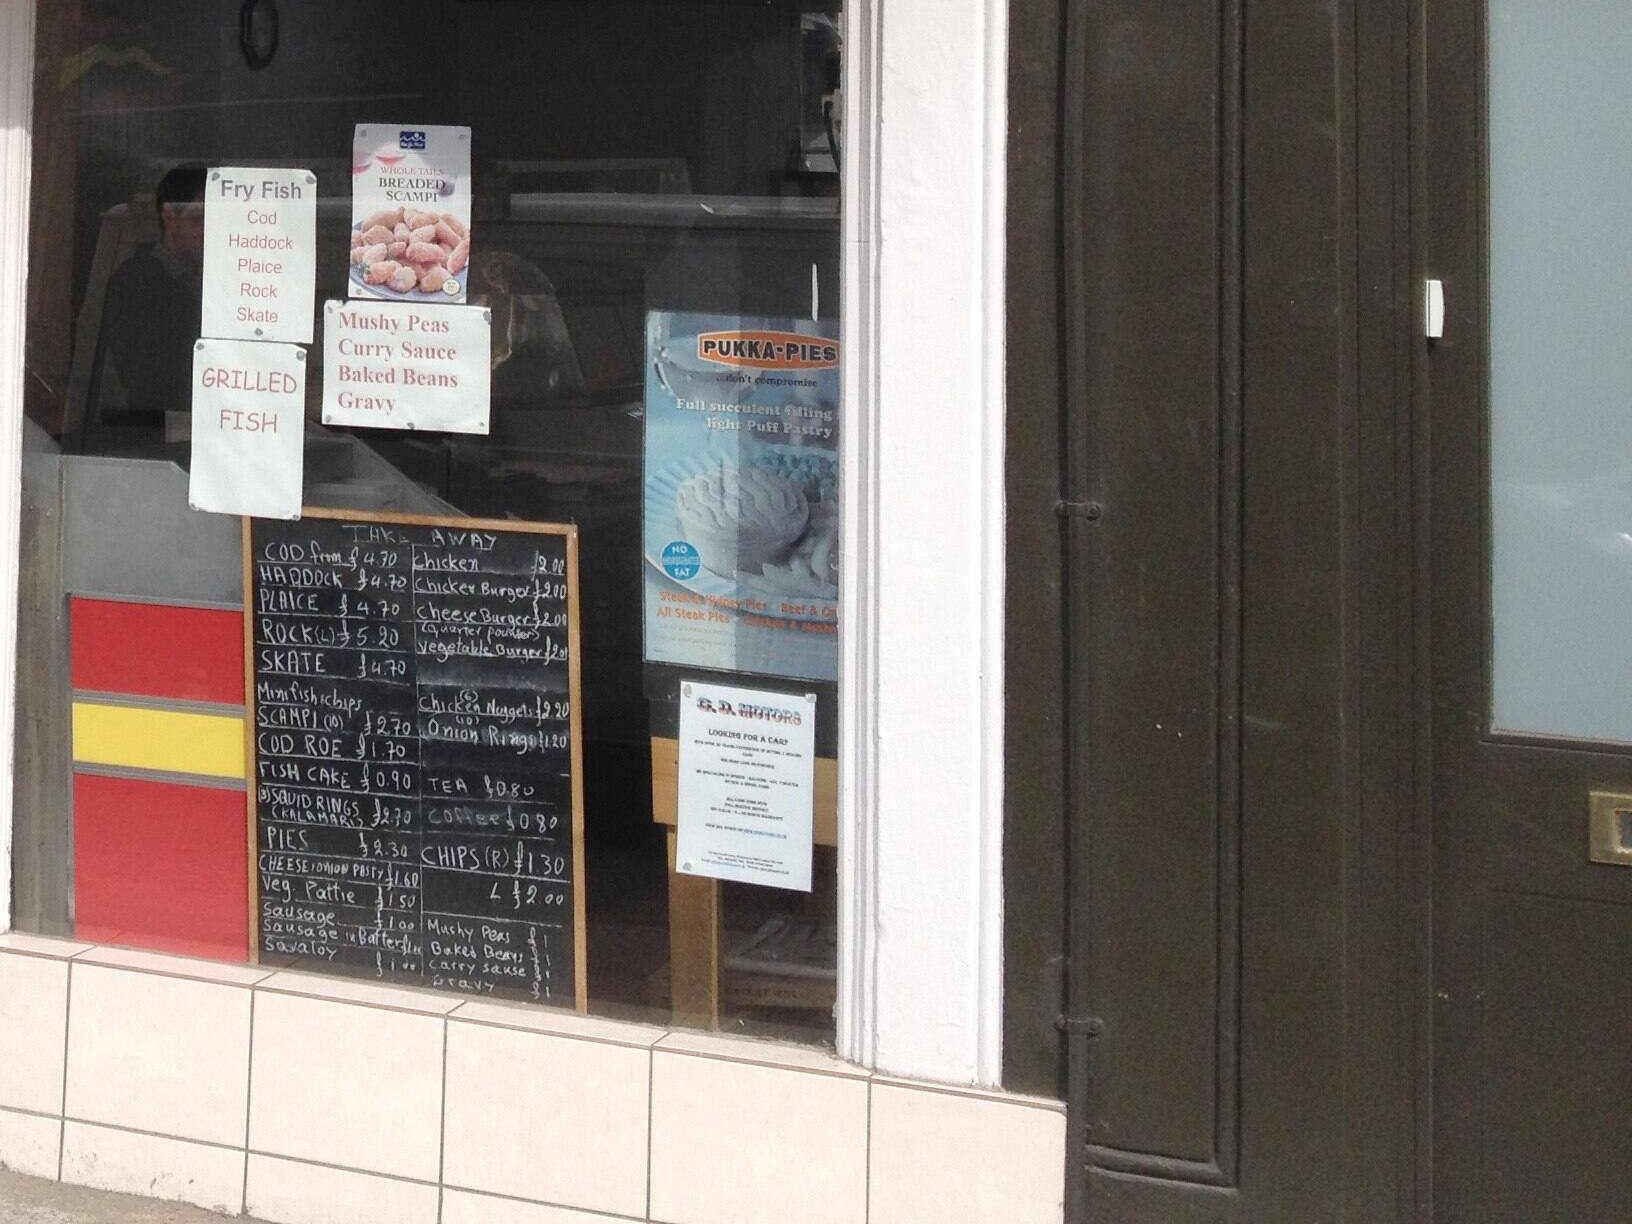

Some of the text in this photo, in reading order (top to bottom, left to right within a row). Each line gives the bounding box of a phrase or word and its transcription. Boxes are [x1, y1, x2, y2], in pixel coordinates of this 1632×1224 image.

[221, 179, 302, 202] Fry Fish
[379, 177, 446, 189] BREADED
[386, 190, 437, 202] SCAMPI
[247, 209, 277, 225] Cod
[228, 233, 294, 250] Haddock
[237, 258, 283, 274] Plaice
[240, 282, 278, 298] Rock
[236, 306, 279, 323] Skate
[338, 312, 450, 336] Mushy Peas
[338, 338, 457, 362] Curry Sauce
[703, 339, 837, 362] PUKKA-PIES
[201, 367, 297, 394] GRILLED
[338, 364, 458, 388] Baked Beans
[338, 392, 396, 416] Gravy
[676, 398, 705, 411] Full
[709, 402, 781, 416] succulent
[219, 409, 278, 433] FISH
[784, 422, 833, 439] Pastry
[265, 542, 304, 561] COD
[310, 540, 342, 565] from
[413, 551, 479, 570] Chicken
[672, 545, 688, 554] NO
[260, 564, 342, 589] HADDOCK
[260, 588, 318, 613] PLAICE
[481, 582, 529, 602] Burger
[261, 650, 326, 675] SKATE
[258, 706, 317, 729] SCAMPI
[428, 718, 478, 744] Onion
[743, 733, 758, 742] FOR
[760, 735, 766, 743] A
[258, 732, 294, 754] COD
[305, 734, 342, 758] ROE
[259, 762, 299, 781] FISH
[308, 767, 350, 789] CAKE
[427, 777, 468, 793] TEA
[317, 796, 359, 817] RINGS
[267, 826, 309, 851] PIES
[421, 845, 480, 870] CHIPS
[306, 880, 355, 904] Pattie
[263, 901, 335, 929] Sausage
[263, 918, 338, 943] Sausage
[427, 919, 474, 937] Mushy
[265, 936, 337, 960] Savaloy
